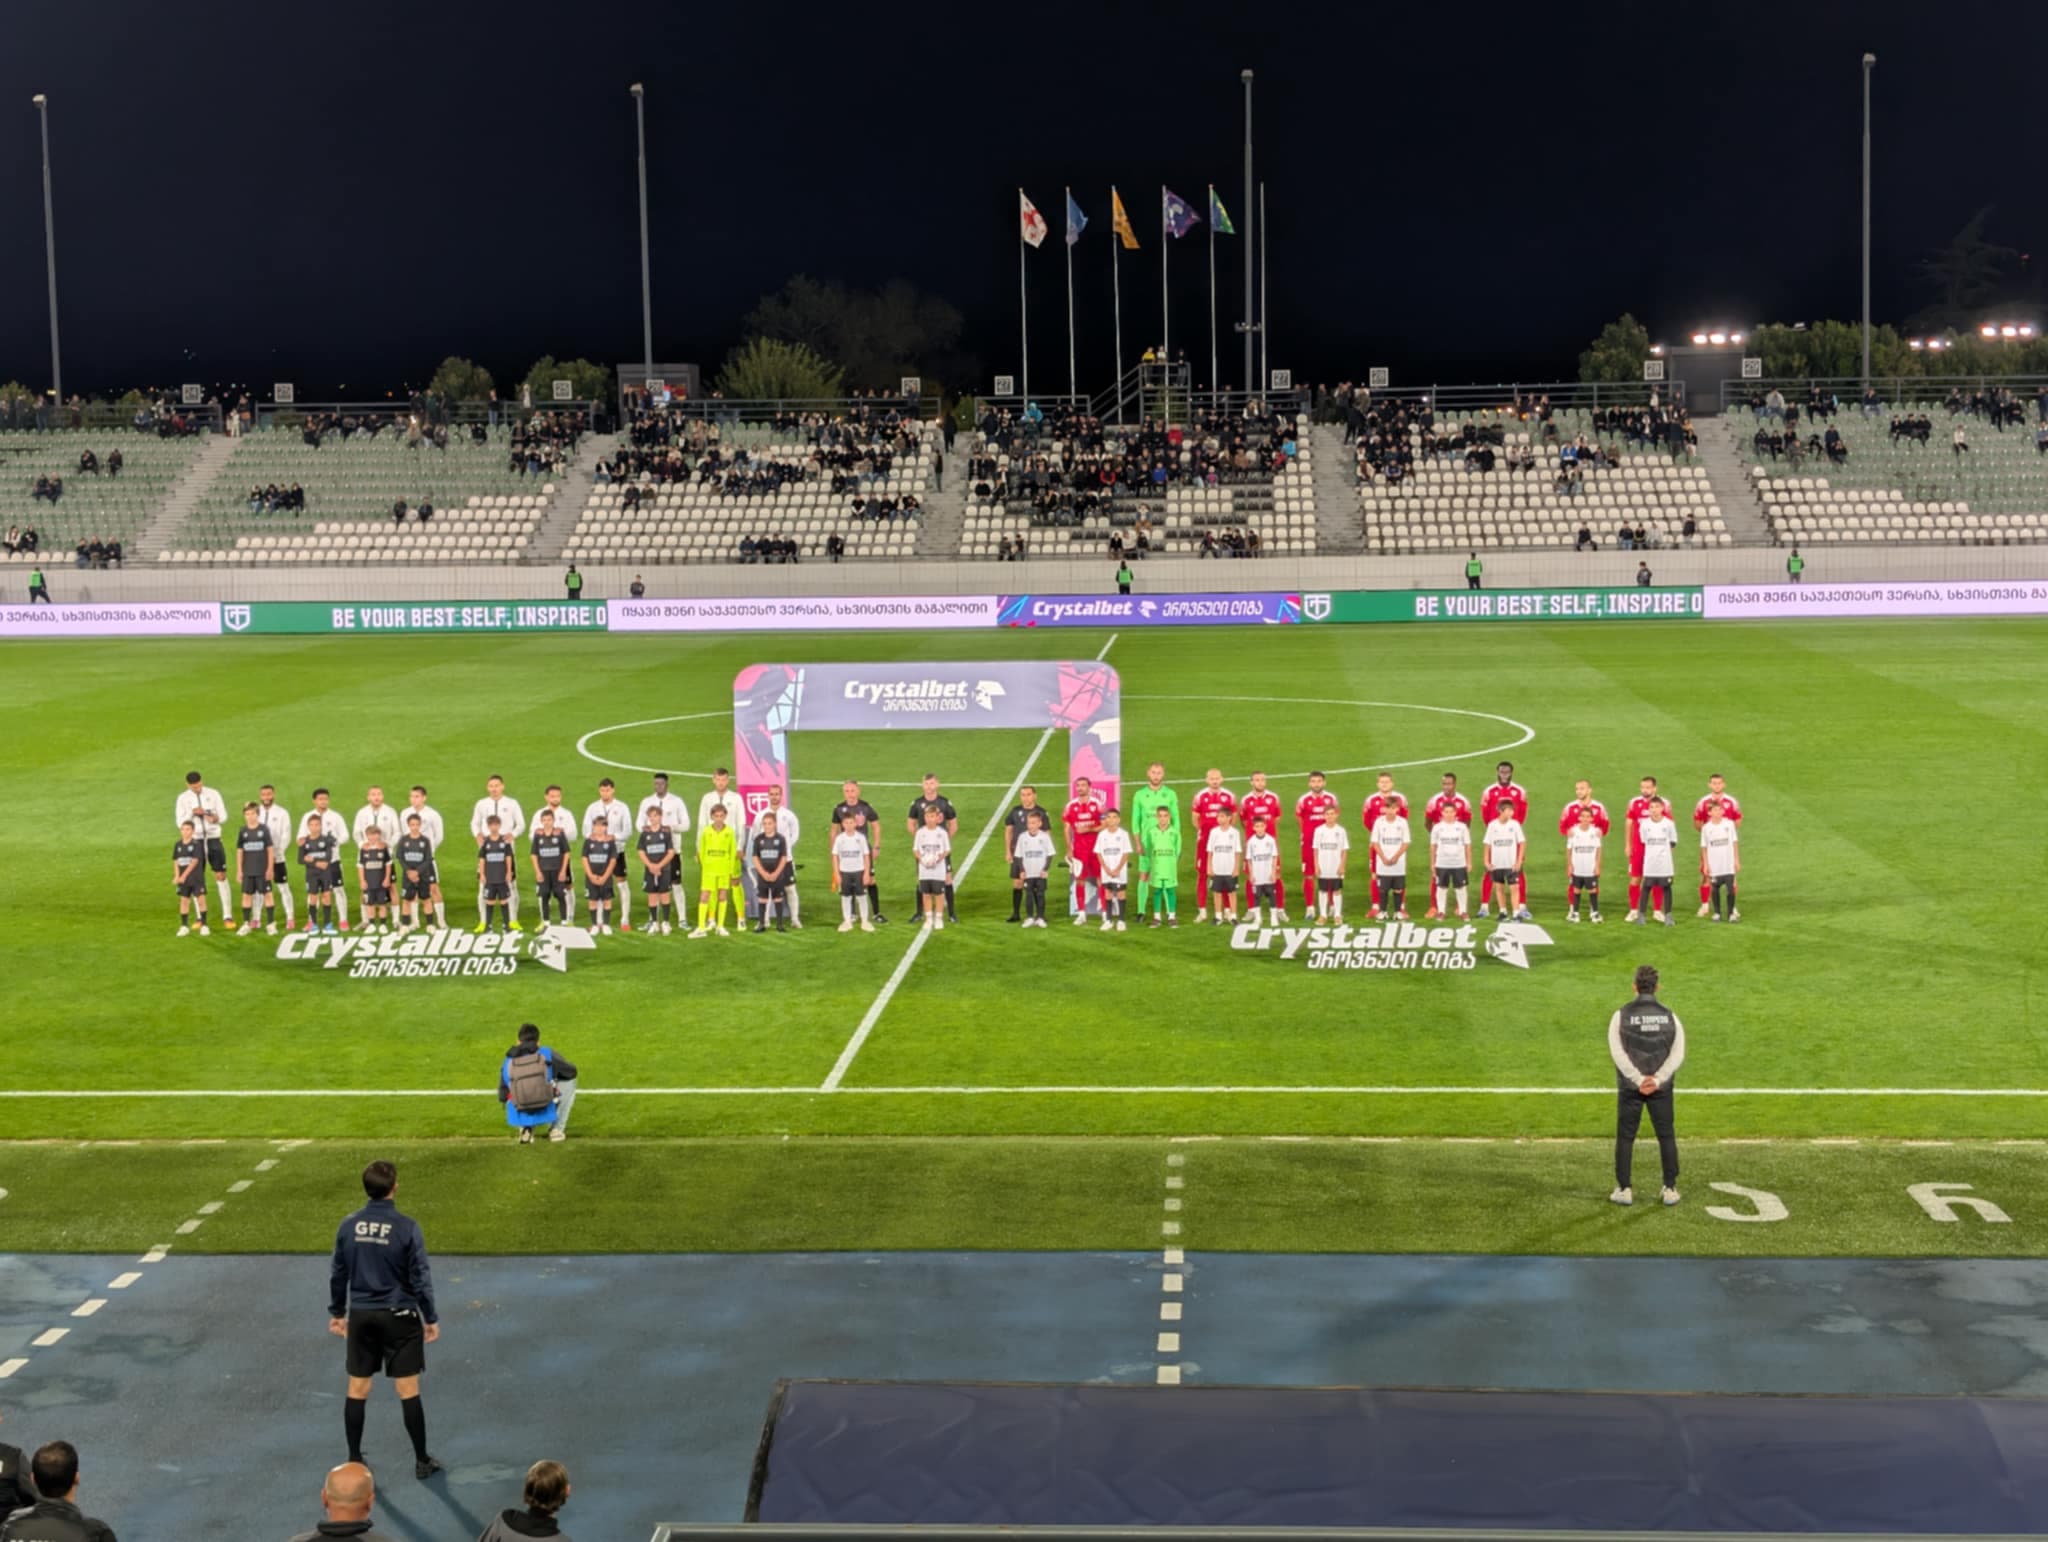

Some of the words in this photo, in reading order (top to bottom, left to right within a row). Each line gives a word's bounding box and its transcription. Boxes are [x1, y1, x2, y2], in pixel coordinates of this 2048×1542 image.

[1415, 596, 1439, 616] BE
[1445, 595, 1491, 616] YOUR
[1497, 595, 1543, 615] BEST
[1550, 594, 1603, 617] SELF,
[1609, 593, 1685, 614] INSPIRE
[1718, 592, 1760, 604] იყავი
[1763, 591, 1797, 603] შენი
[139, 609, 212, 621] მაგალითი
[332, 607, 355, 628] BE
[360, 607, 405, 628] YOUR
[411, 607, 455, 628] BEST
[462, 606, 512, 629] SELF,
[517, 605, 590, 626] INSPIRE
[622, 606, 661, 617] იყავი
[664, 605, 695, 617] შენი
[915, 603, 988, 615] მაგალითი
[1033, 601, 1132, 621] Crystalbet
[844, 680, 969, 705] Crystalbet
[276, 928, 524, 968] Crystalbet
[1230, 922, 1478, 959] Crystalbet
[349, 957, 459, 977] ეროვნული
[461, 956, 518, 975] ლიგა
[1307, 951, 1417, 969] ეროვნული
[1420, 950, 1477, 969] ლიგა
[355, 1221, 393, 1238] GFF
